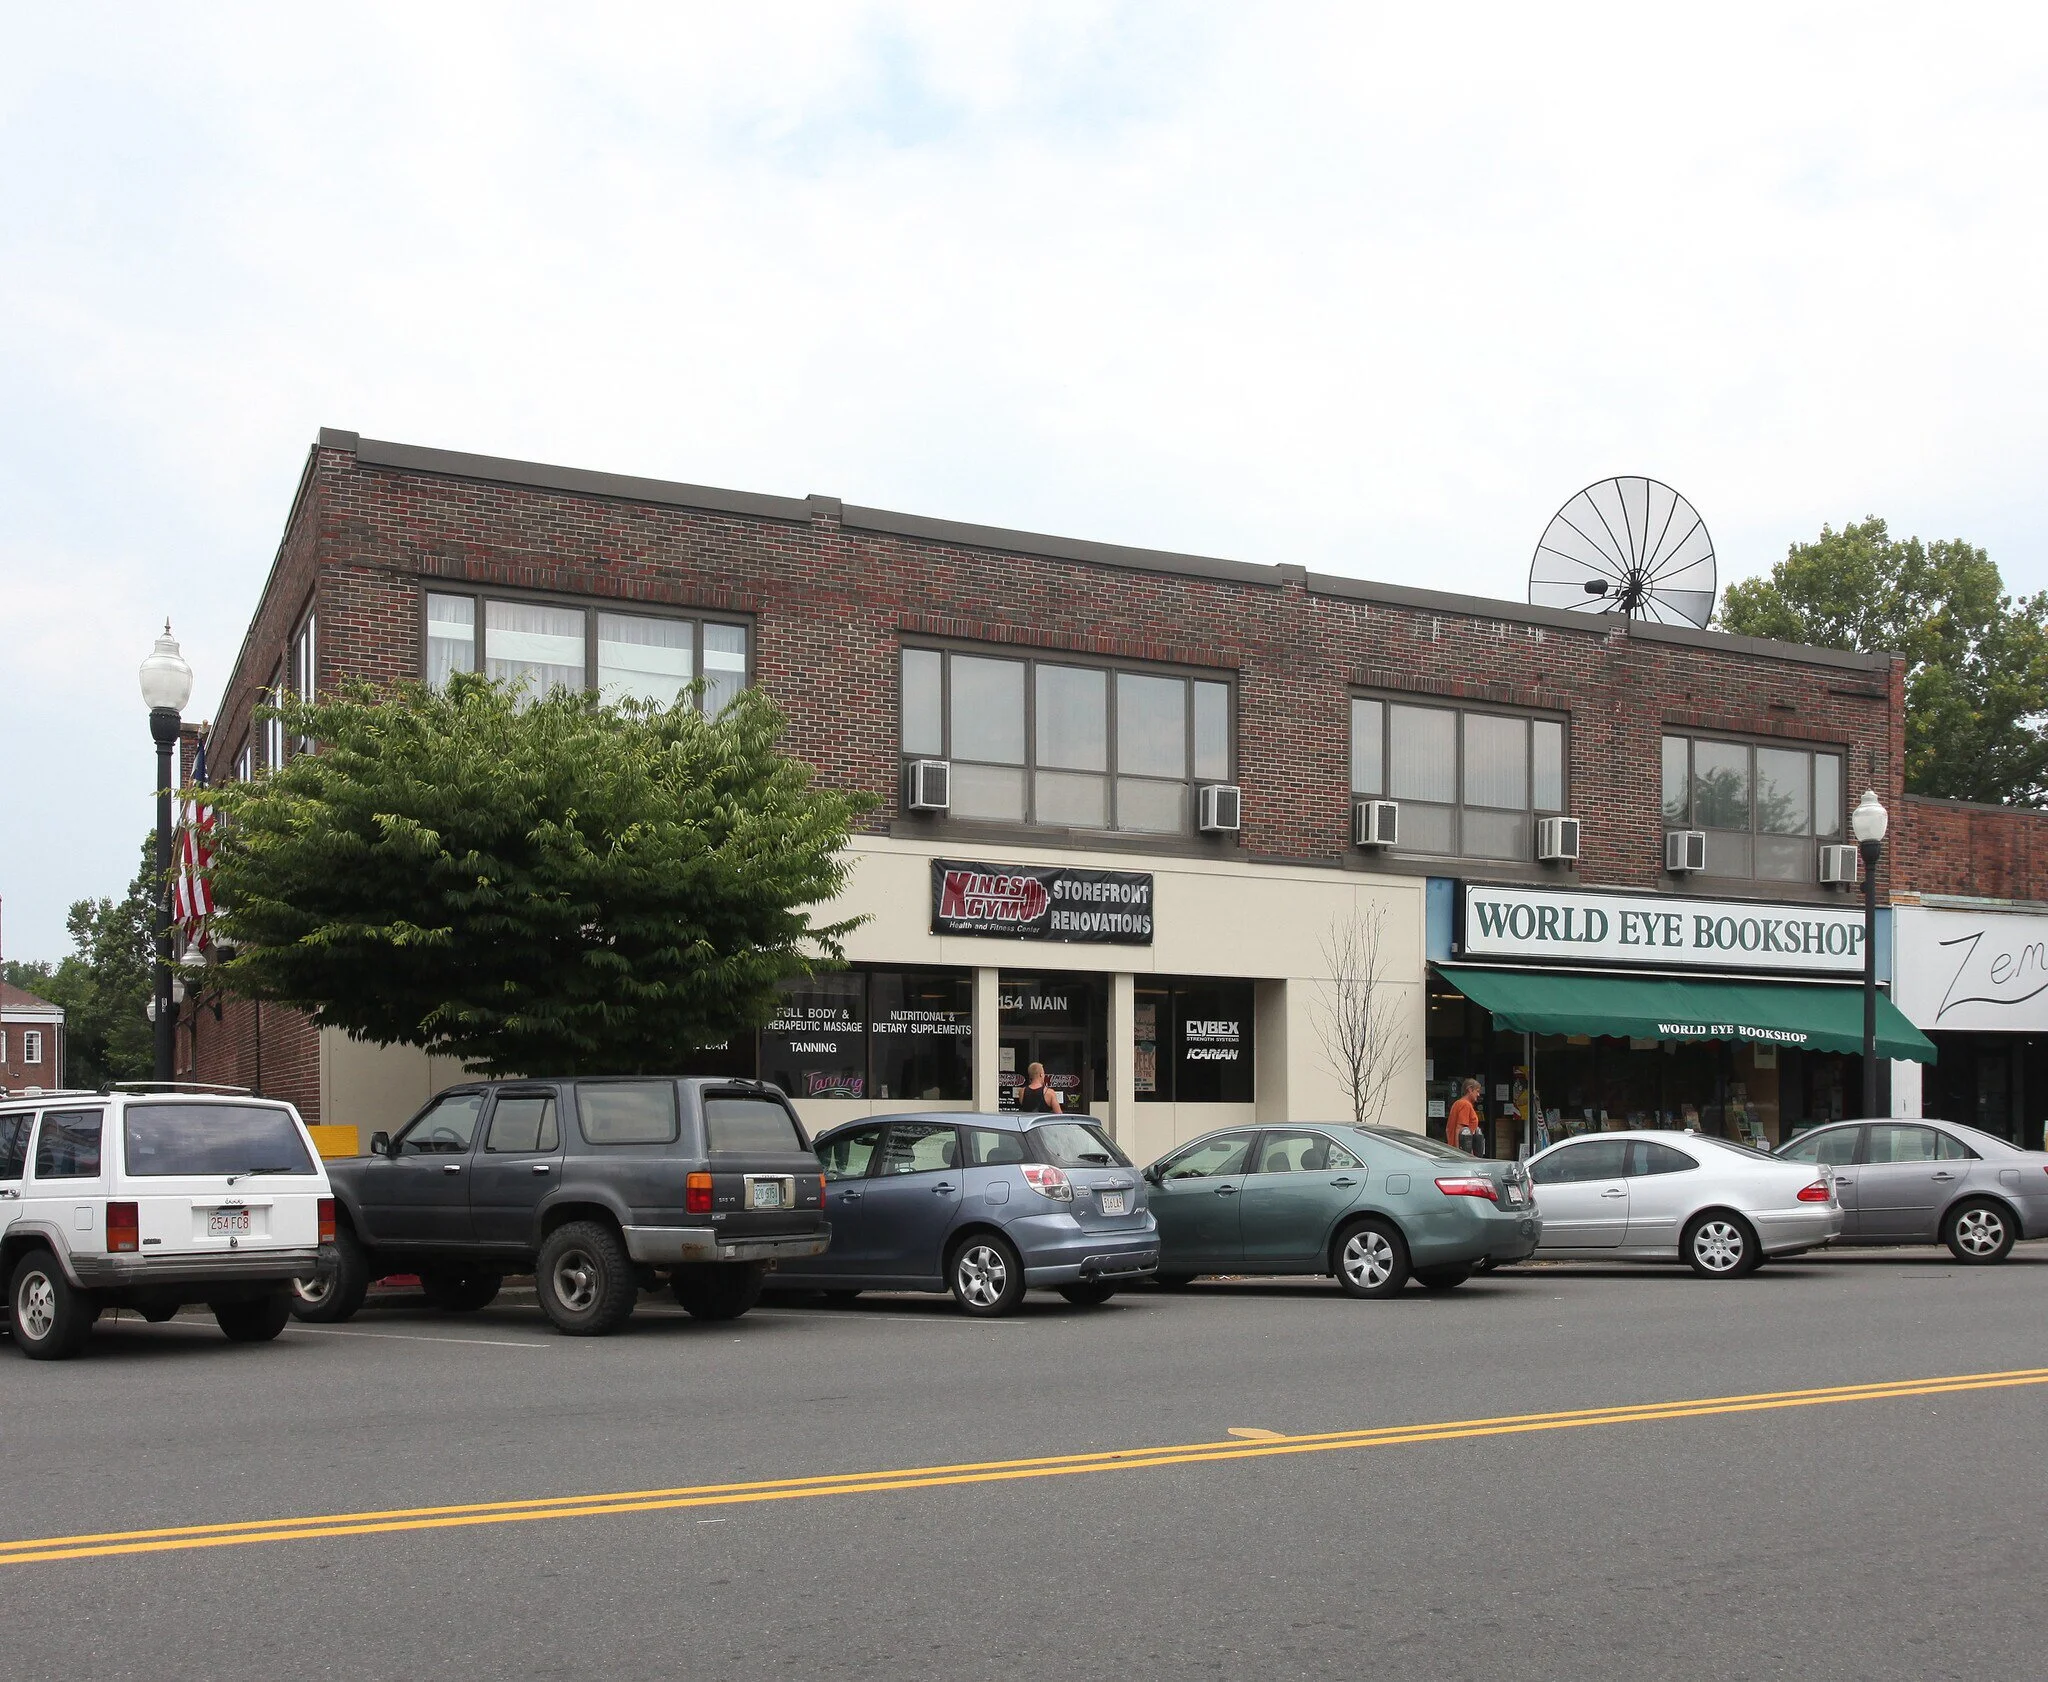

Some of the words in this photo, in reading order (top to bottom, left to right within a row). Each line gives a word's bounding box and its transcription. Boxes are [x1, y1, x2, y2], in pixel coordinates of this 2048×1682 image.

[939, 870, 1023, 918] KINGS
[1053, 880, 1149, 904] STOREFRONT
[966, 899, 1023, 920] GYM
[949, 920, 973, 929] Health
[974, 922, 988, 930] and
[990, 923, 1015, 932] Fitness
[1017, 925, 1040, 934] Center
[1051, 910, 1151, 934] RENOVATIONS
[1473, 902, 1609, 943] WORLD
[1618, 910, 1683, 947] EYE
[1692, 915, 1865, 956] BOOKSHOP
[998, 996, 1023, 1010] 154
[1030, 996, 1068, 1011] MAIN
[776, 1007, 804, 1018] FULL
[808, 1008, 837, 1019] BODY
[841, 1009, 850, 1019] &
[890, 1010, 946, 1022] NUTRITIONAL
[948, 1012, 955, 1022] &
[763, 1020, 821, 1031] HERAPEUTIC
[823, 1021, 863, 1032] MASSAGE
[872, 1022, 907, 1034] DIETARY
[911, 1023, 972, 1035] SUPPLEMENTS
[1186, 1020, 1240, 1036] CYBEX
[1658, 1023, 1706, 1035] WORLD
[1710, 1024, 1734, 1035] EYE
[1738, 1025, 1808, 1043] BOOKSHOP
[790, 1042, 837, 1053] TANNING
[805, 1071, 864, 1094] Tanning
[211, 1216, 228, 1230] 254
[231, 1216, 249, 1229] FC8
